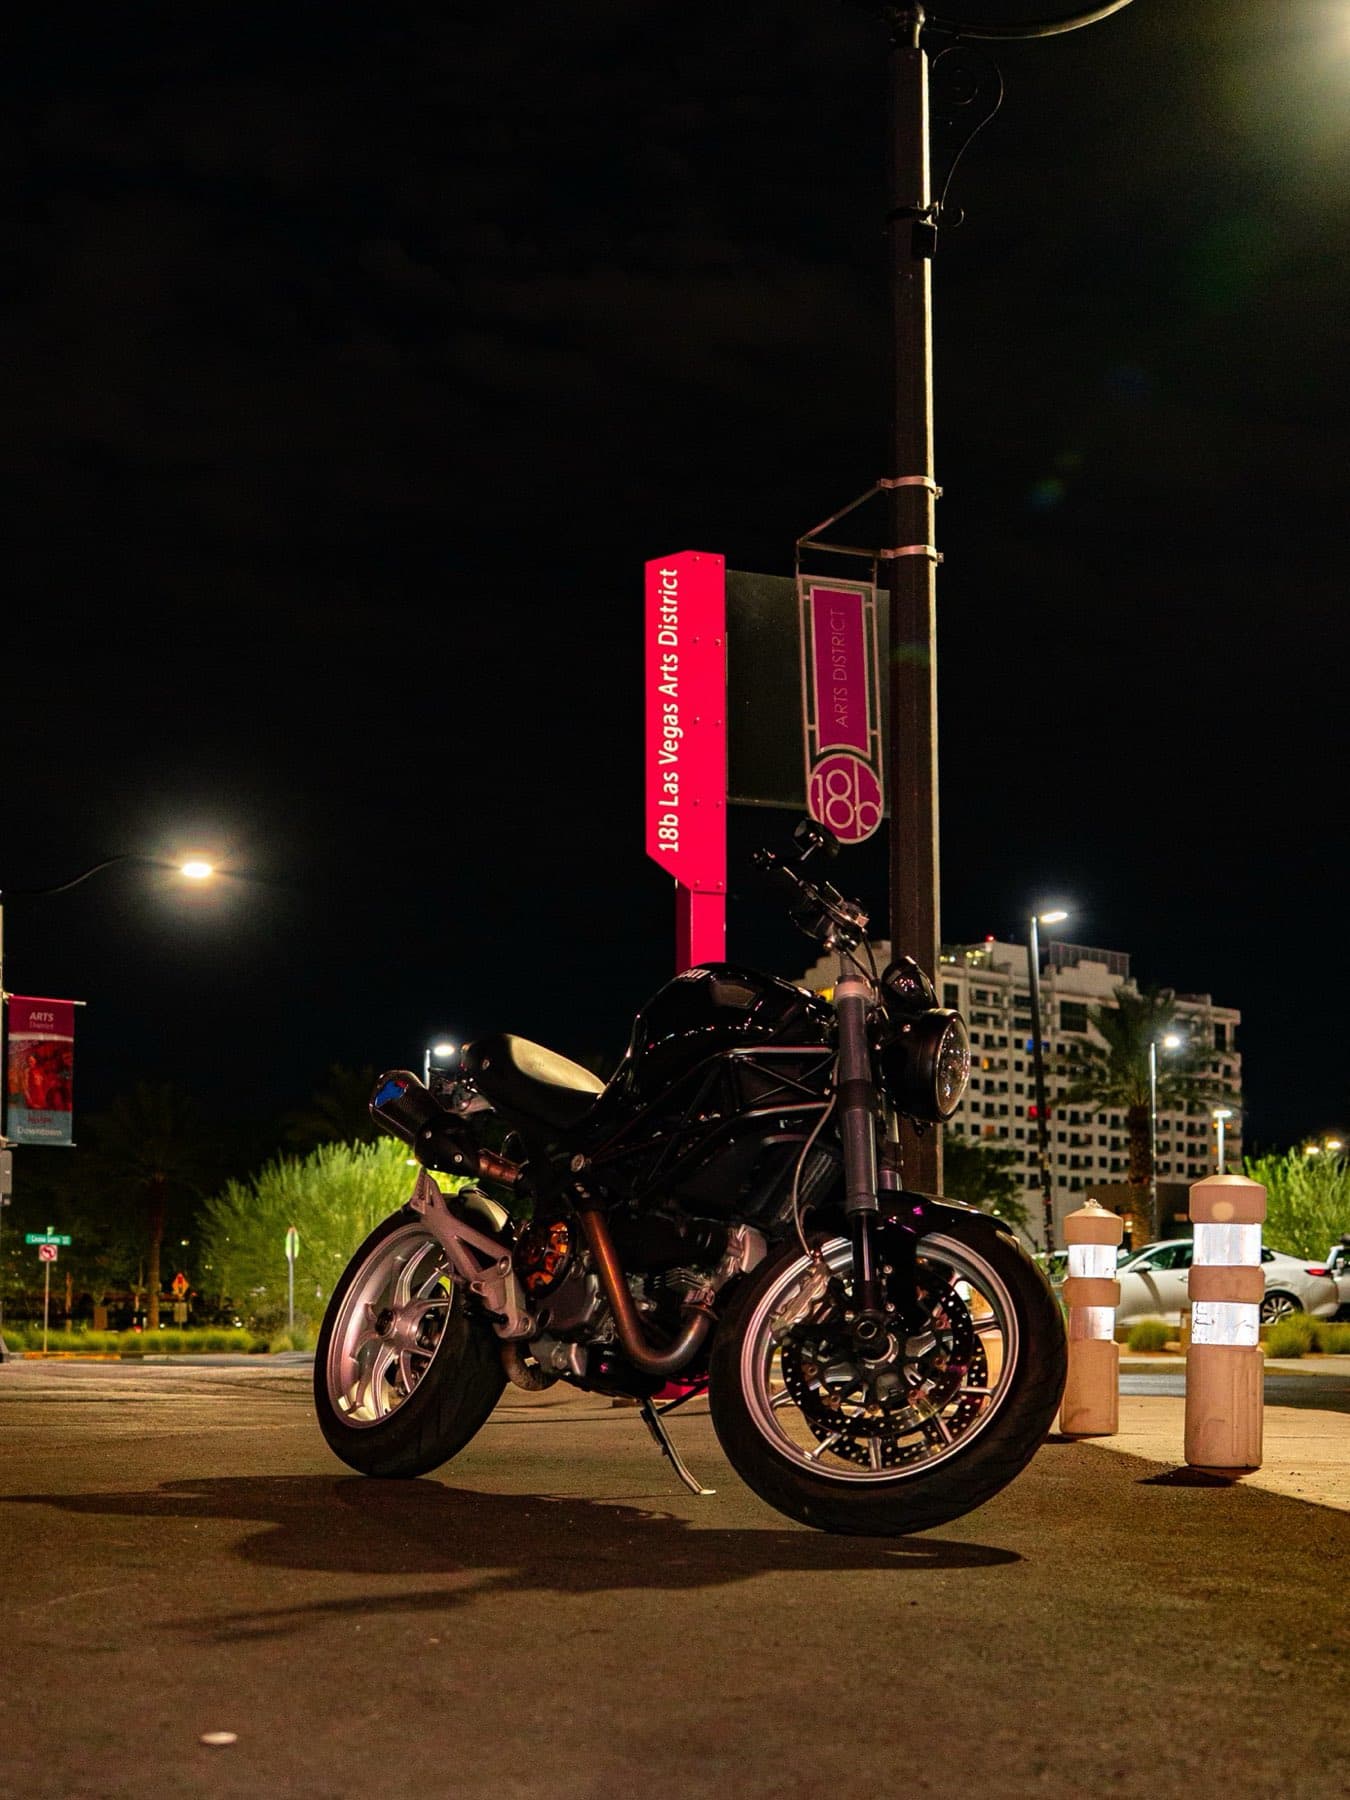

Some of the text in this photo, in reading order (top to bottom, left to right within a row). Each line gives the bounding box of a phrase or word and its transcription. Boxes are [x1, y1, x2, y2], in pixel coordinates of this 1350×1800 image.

[658, 568, 684, 853] 18b Las Vegas Arts District
[830, 609, 849, 728] ARTS DISTRICT
[29, 1011, 54, 1022] ARTS
